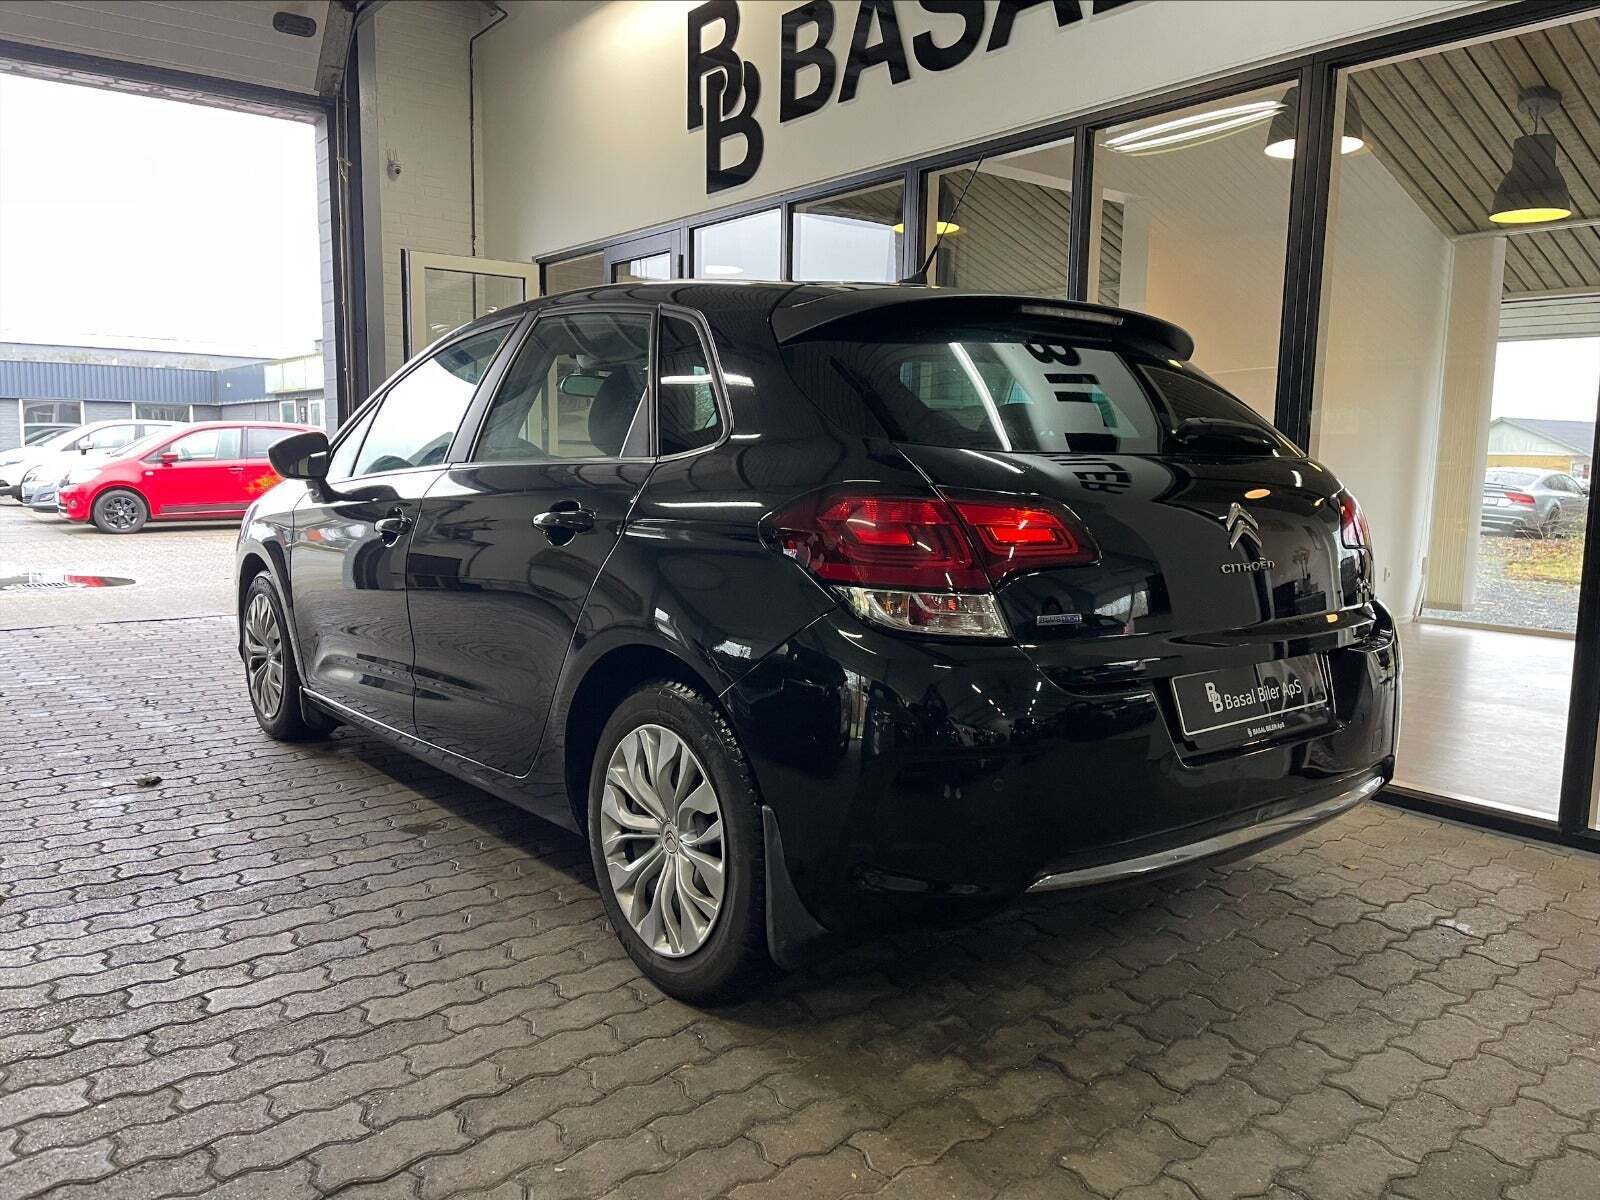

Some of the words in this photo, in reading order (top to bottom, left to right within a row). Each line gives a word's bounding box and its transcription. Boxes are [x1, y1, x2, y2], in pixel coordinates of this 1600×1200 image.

[1224, 689, 1256, 710] Basal
[1257, 684, 1280, 703] Biler
[1282, 679, 1302, 699] ApS
